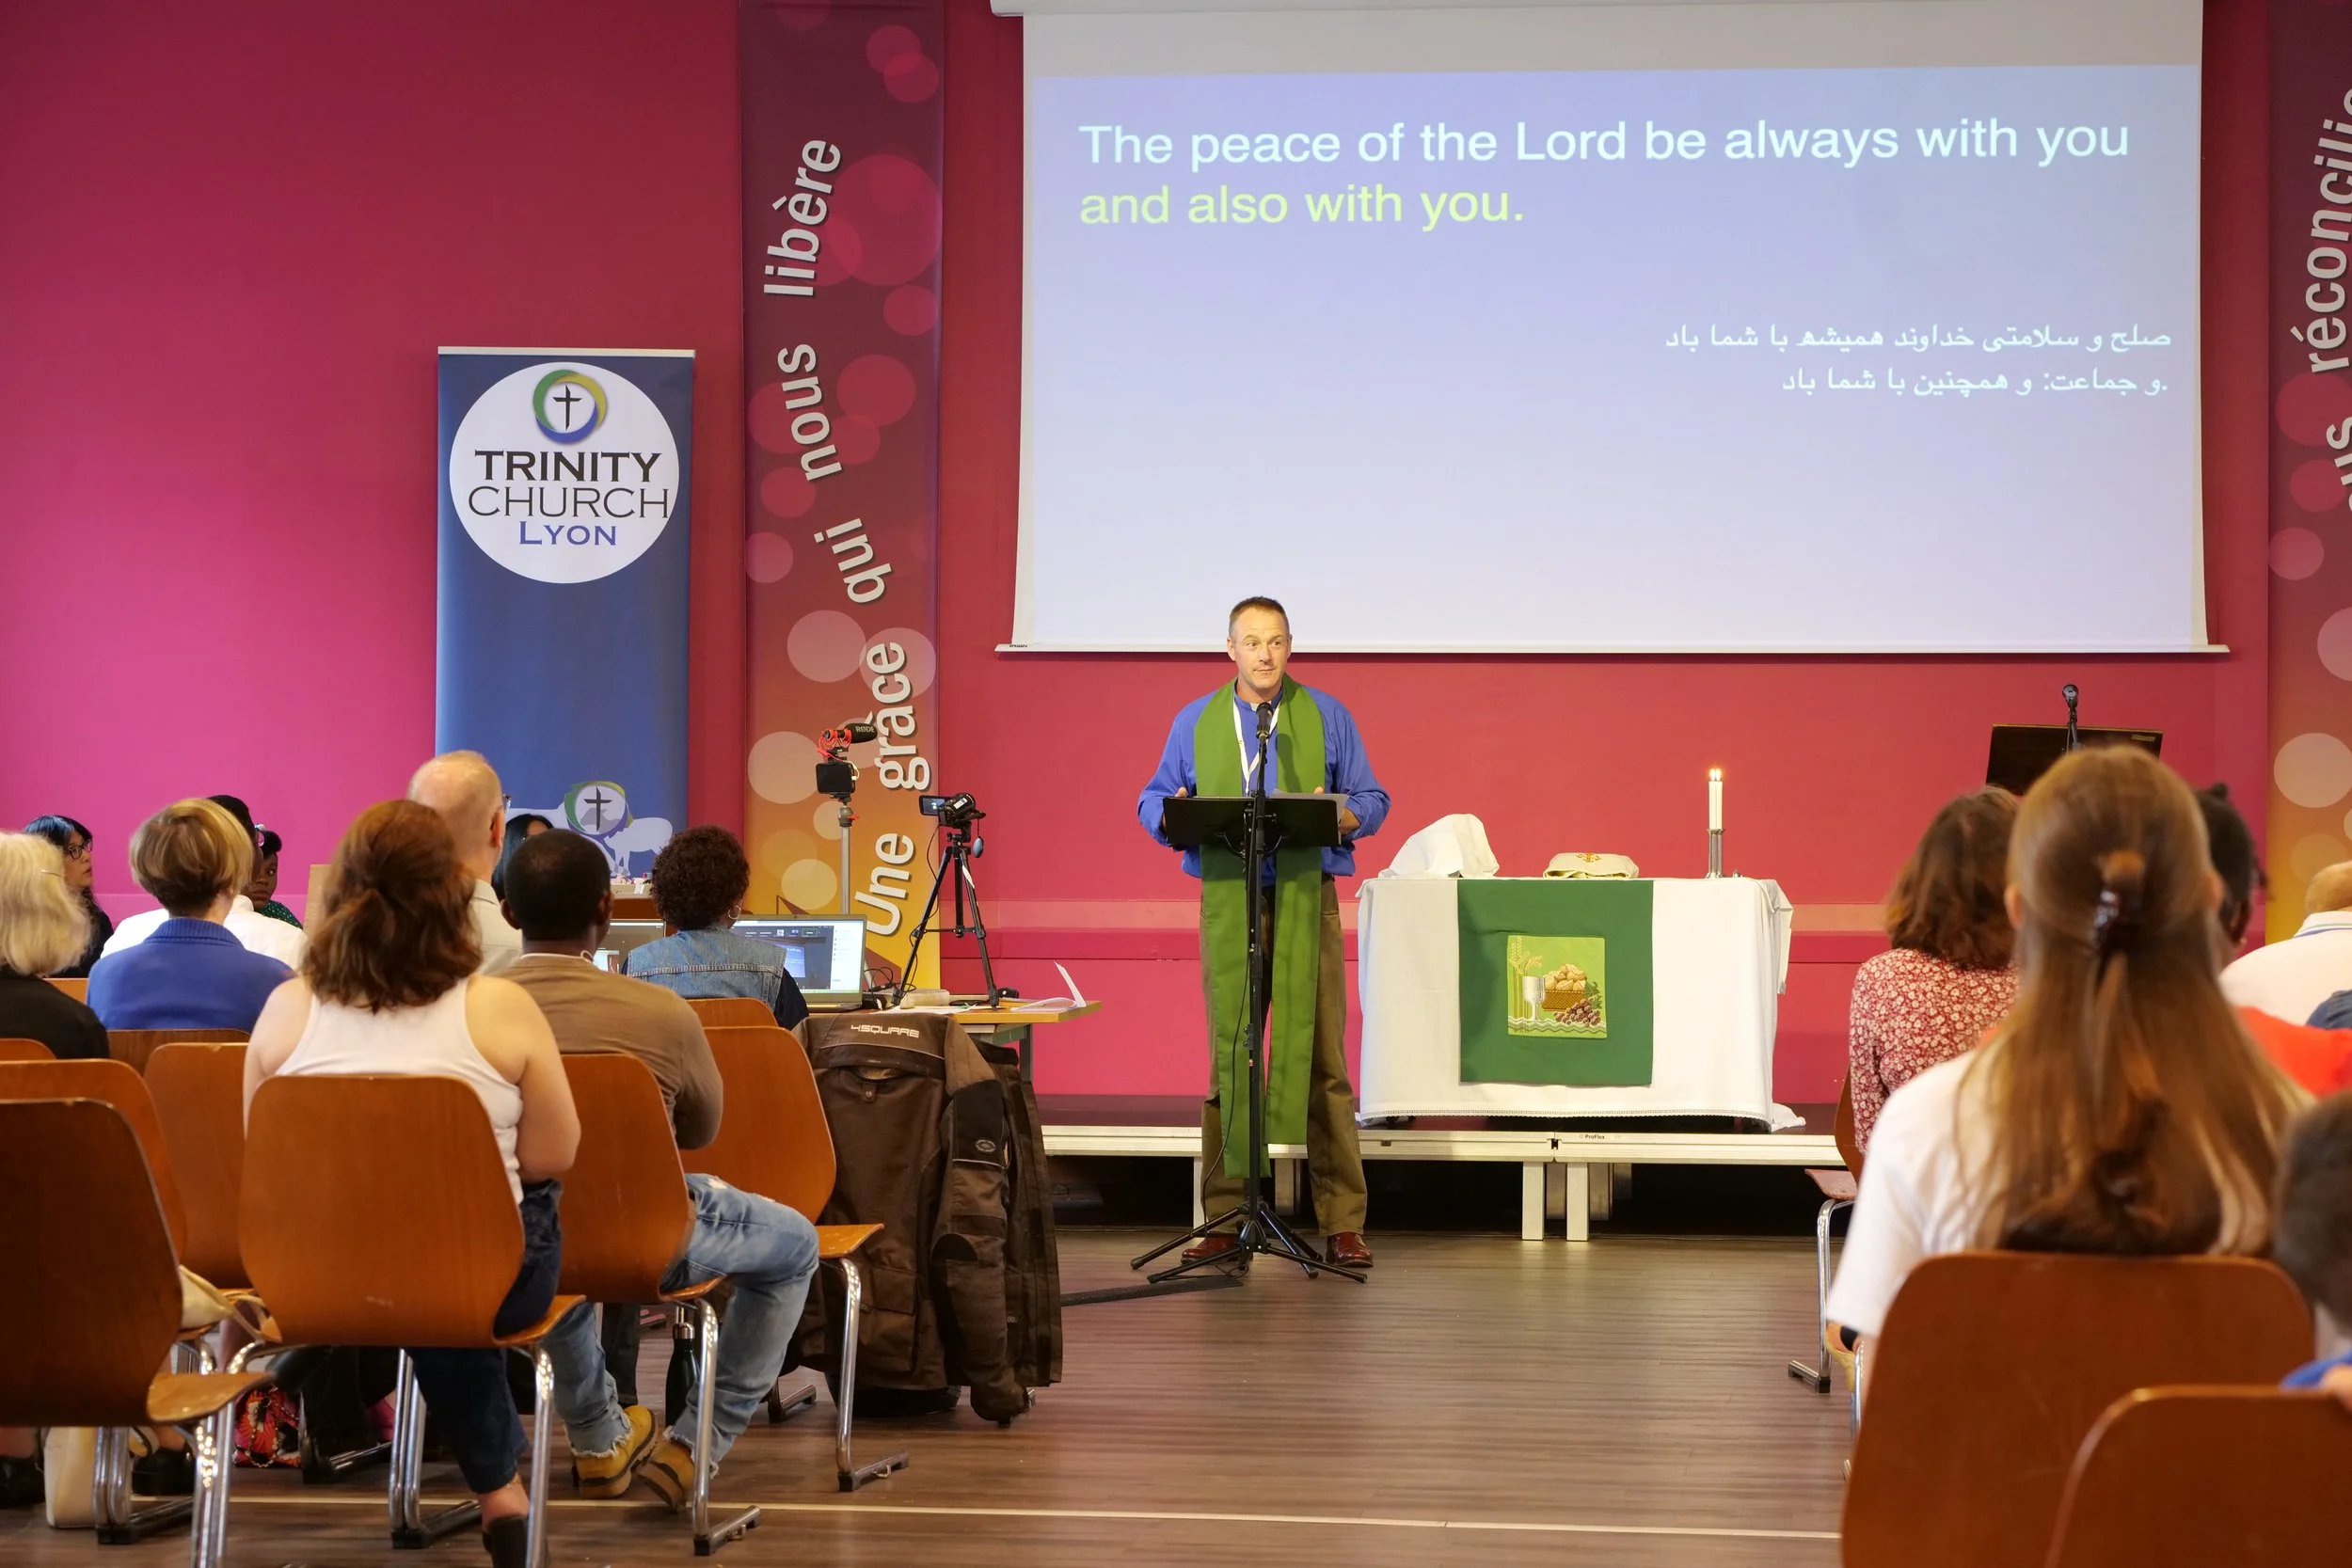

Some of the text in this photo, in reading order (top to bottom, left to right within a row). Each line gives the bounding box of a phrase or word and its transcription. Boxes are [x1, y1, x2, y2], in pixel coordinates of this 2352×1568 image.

[1079, 118, 2129, 172] The peace of the Lord be always with you
[763, 139, 842, 296] libère
[1080, 183, 1524, 231] and also with you.
[2290, 87, 2352, 372] réconcili
[1665, 323, 1699, 353] باد
[1710, 323, 1758, 347] شما
[1771, 323, 1788, 353] با
[1894, 324, 1975, 353] خداوند
[1982, 325, 2079, 353] سلامتی
[2085, 334, 2103, 353] و
[2110, 323, 2171, 353] صلح
[1782, 367, 1816, 396] باد
[1828, 367, 1876, 390] شما
[1887, 367, 1906, 396] با
[1913, 371, 2009, 398] همچنین
[2015, 378, 2032, 396] و
[777, 343, 842, 481] nous
[474, 449, 662, 483] TRINITY
[468, 485, 669, 519] CHURCH
[814, 517, 892, 604] qui
[854, 832, 915, 936] Une
[850, 1024, 920, 1038] 4SQUARE
